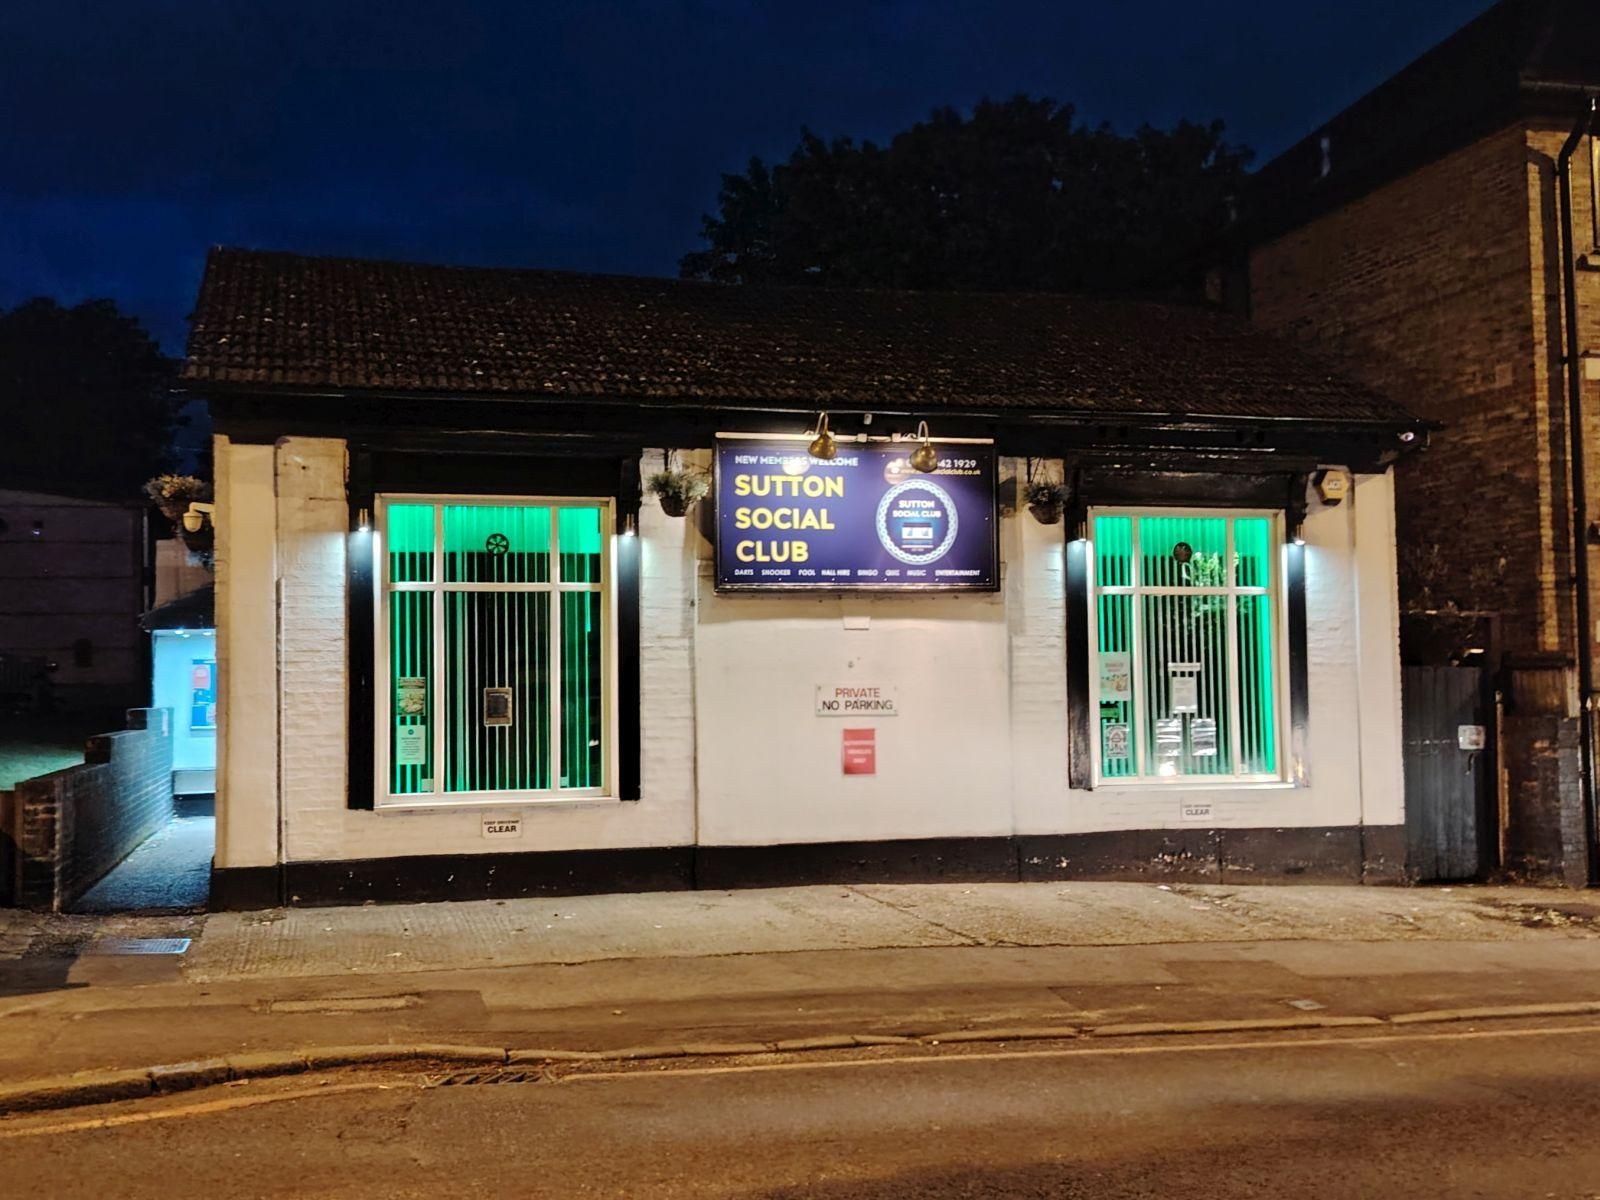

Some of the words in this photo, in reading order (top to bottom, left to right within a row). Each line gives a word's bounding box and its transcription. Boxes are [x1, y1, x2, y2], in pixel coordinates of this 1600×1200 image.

[735, 455, 758, 464] NEW
[953, 459, 977, 468] 1929
[734, 475, 844, 497] SUTTON
[898, 500, 935, 508] SUTTON
[734, 507, 835, 530] SOCIAL
[892, 510, 920, 518] SOCIAL
[921, 510, 942, 518] CLUB
[735, 540, 809, 562] CLUB
[835, 687, 880, 698] PRIVATE
[822, 700, 840, 711] NO
[844, 700, 893, 710] PARKING
[487, 825, 517, 833] CLEAR
